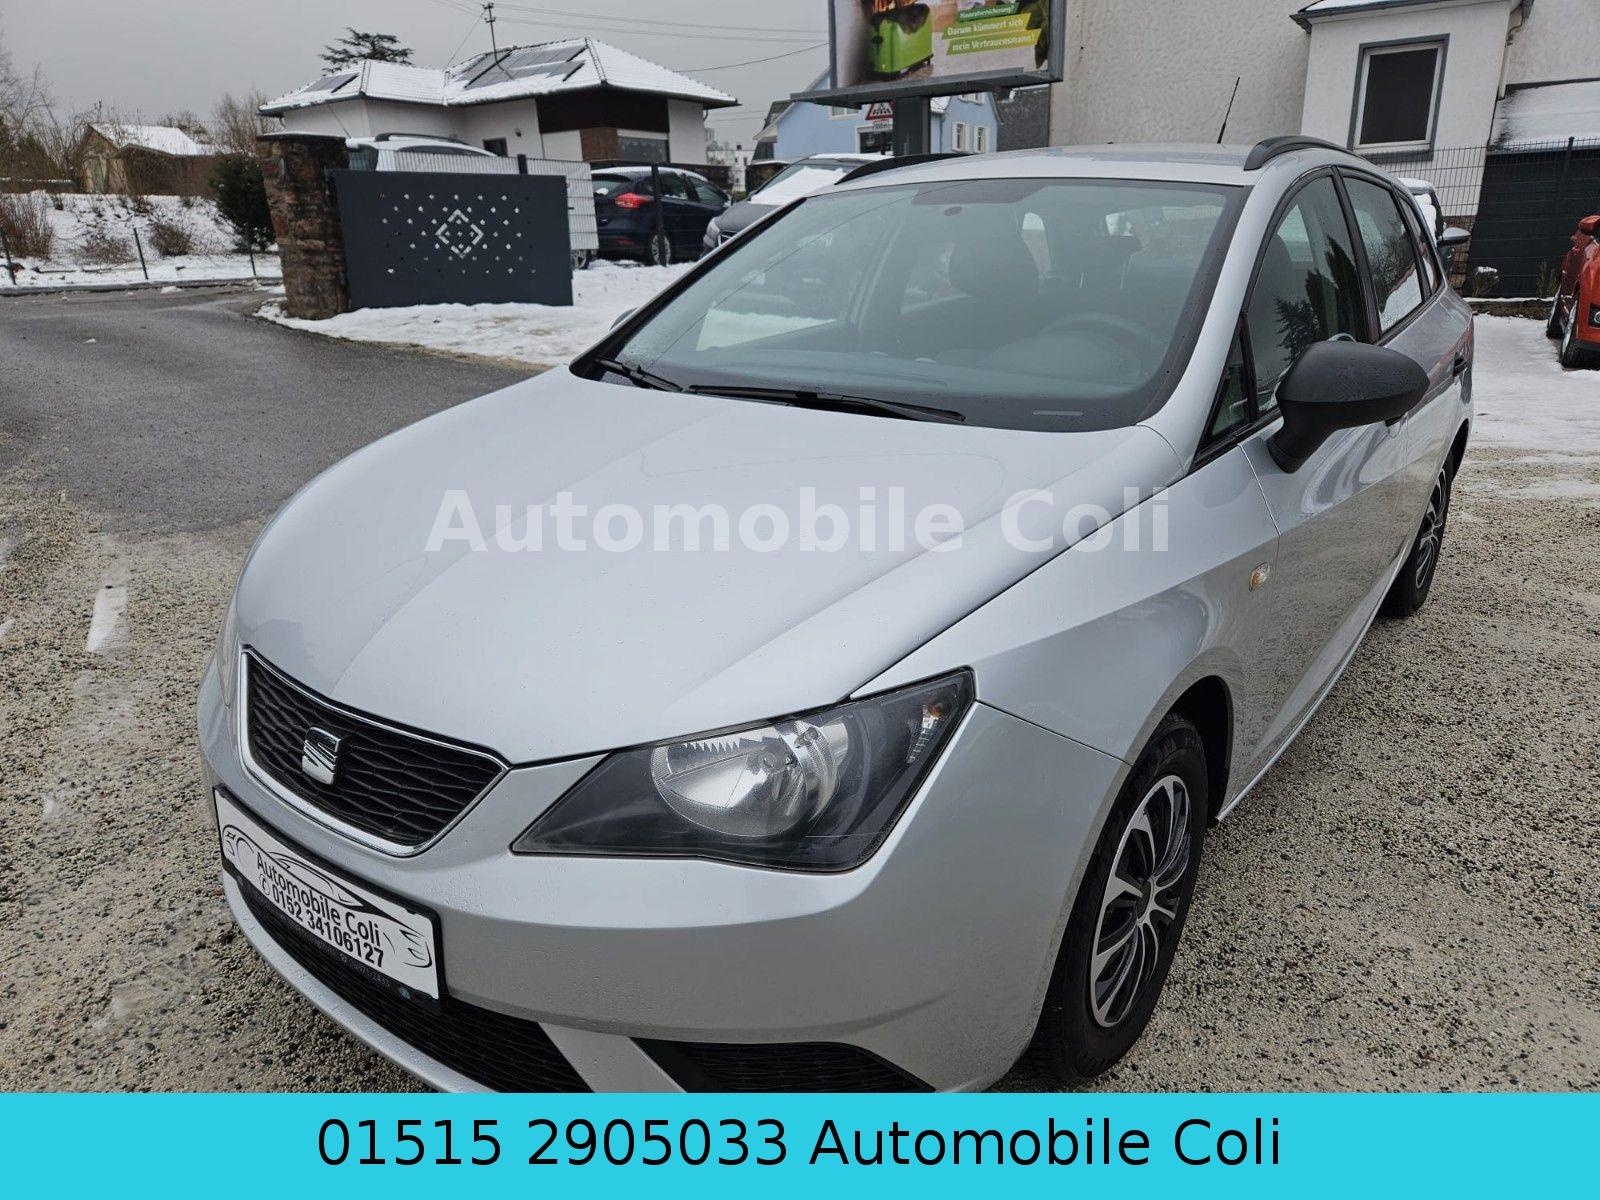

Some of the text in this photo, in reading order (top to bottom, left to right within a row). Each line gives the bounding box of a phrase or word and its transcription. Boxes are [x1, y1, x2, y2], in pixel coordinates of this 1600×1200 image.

[947, 18, 1024, 36] Darum kümmert sich
[952, 43, 970, 51] mein
[257, 852, 381, 948] Automobile Coli
[272, 884, 384, 968] 0152 34106127
